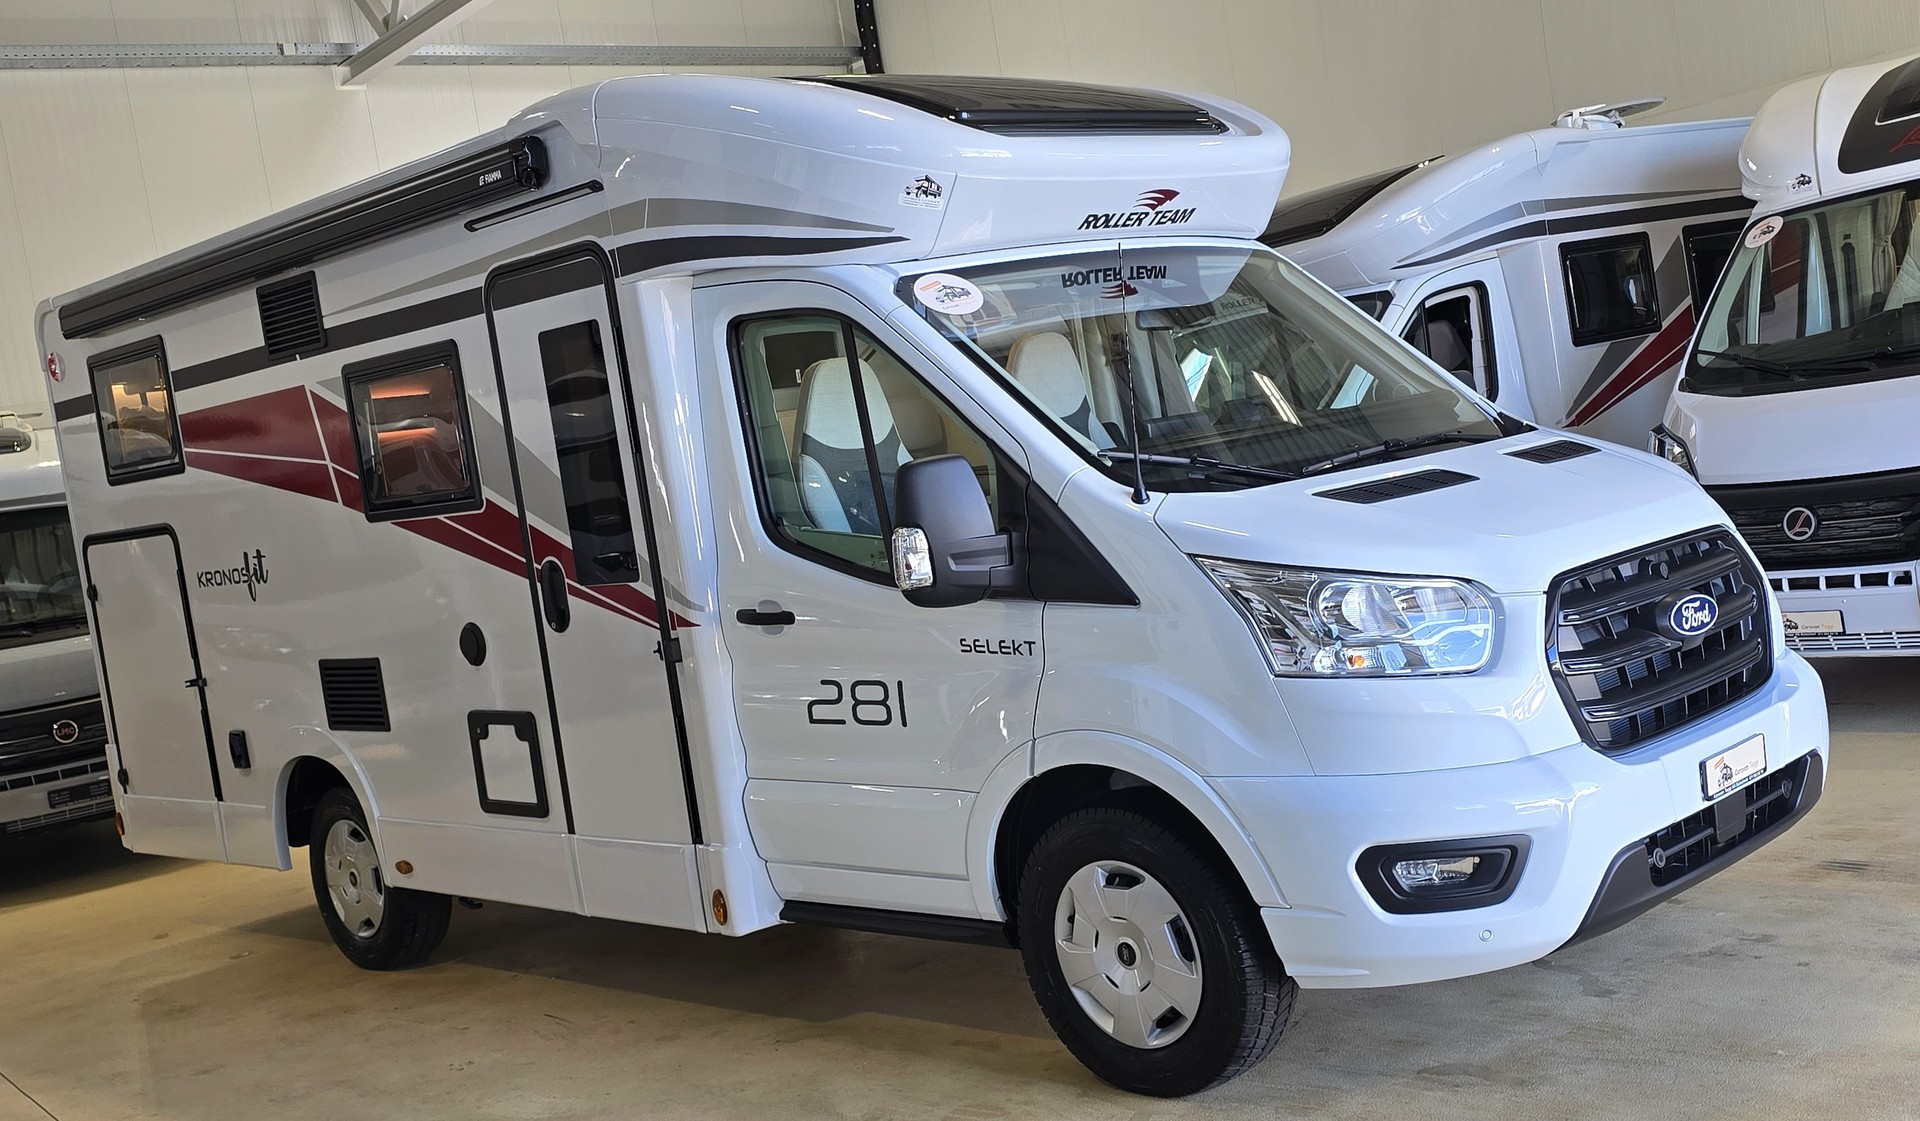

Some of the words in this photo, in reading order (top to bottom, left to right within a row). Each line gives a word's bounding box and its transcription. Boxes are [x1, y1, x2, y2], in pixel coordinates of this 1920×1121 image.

[1077, 212, 1150, 231] ROLLER
[1147, 207, 1197, 227] TEAM
[1681, 600, 1712, 631] Ford
[807, 679, 908, 728] 281
